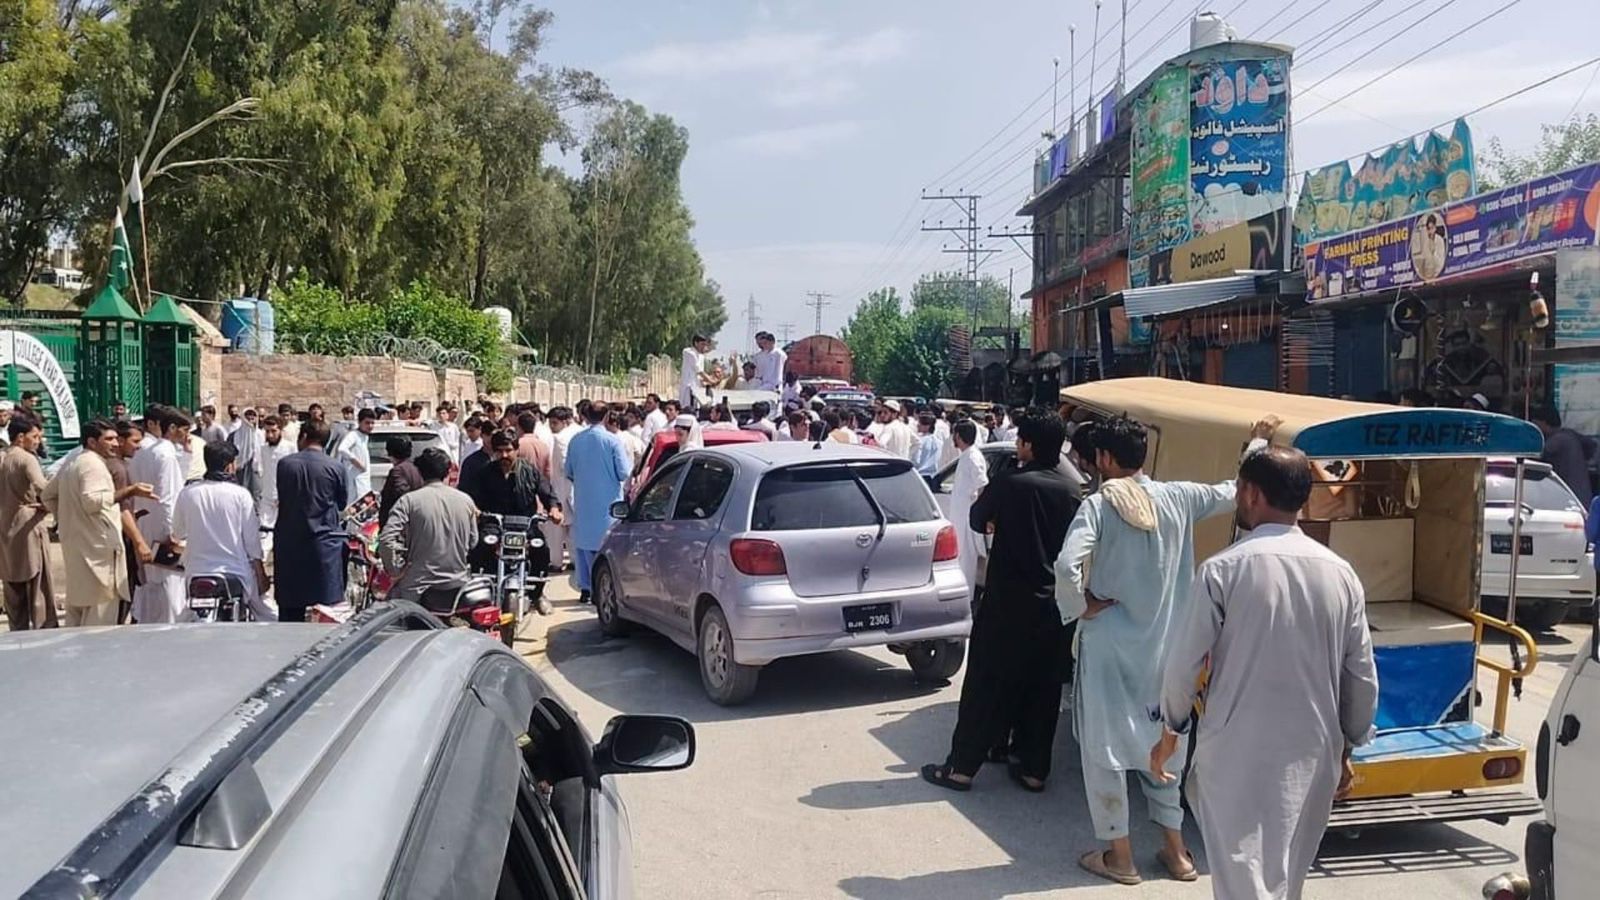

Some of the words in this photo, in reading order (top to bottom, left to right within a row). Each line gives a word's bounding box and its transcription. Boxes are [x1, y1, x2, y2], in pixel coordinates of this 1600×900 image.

[1361, 227, 1409, 251] PRINTING
[1190, 243, 1226, 269] Dawood
[1350, 250, 1379, 268] PRESS
[1362, 423, 1400, 446] TEZ
[869, 614, 890, 626] 2306
